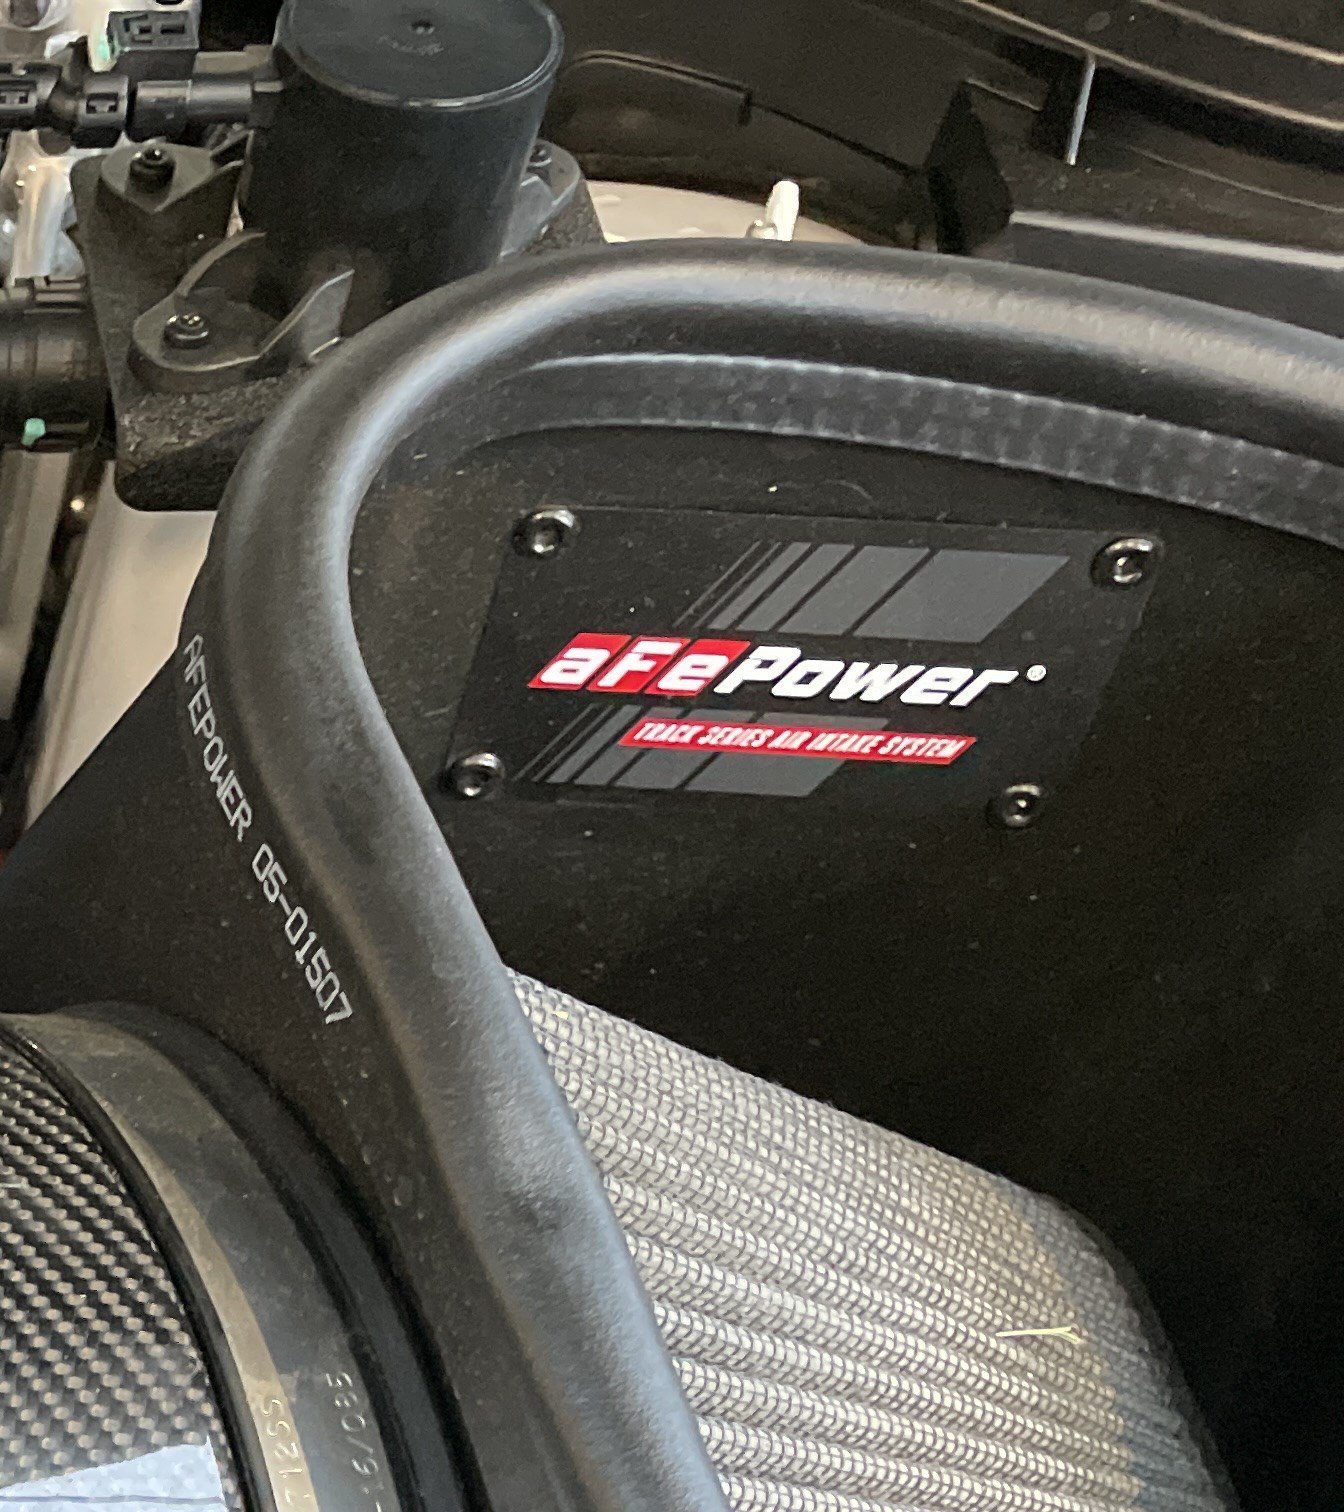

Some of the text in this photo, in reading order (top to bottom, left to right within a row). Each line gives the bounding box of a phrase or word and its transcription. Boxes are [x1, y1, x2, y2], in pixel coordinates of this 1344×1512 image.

[183, 635, 353, 1024] AFEPOWER 05-01507
[633, 722, 968, 759] TRACK SERIES AIR INTAKE SYSTEM
